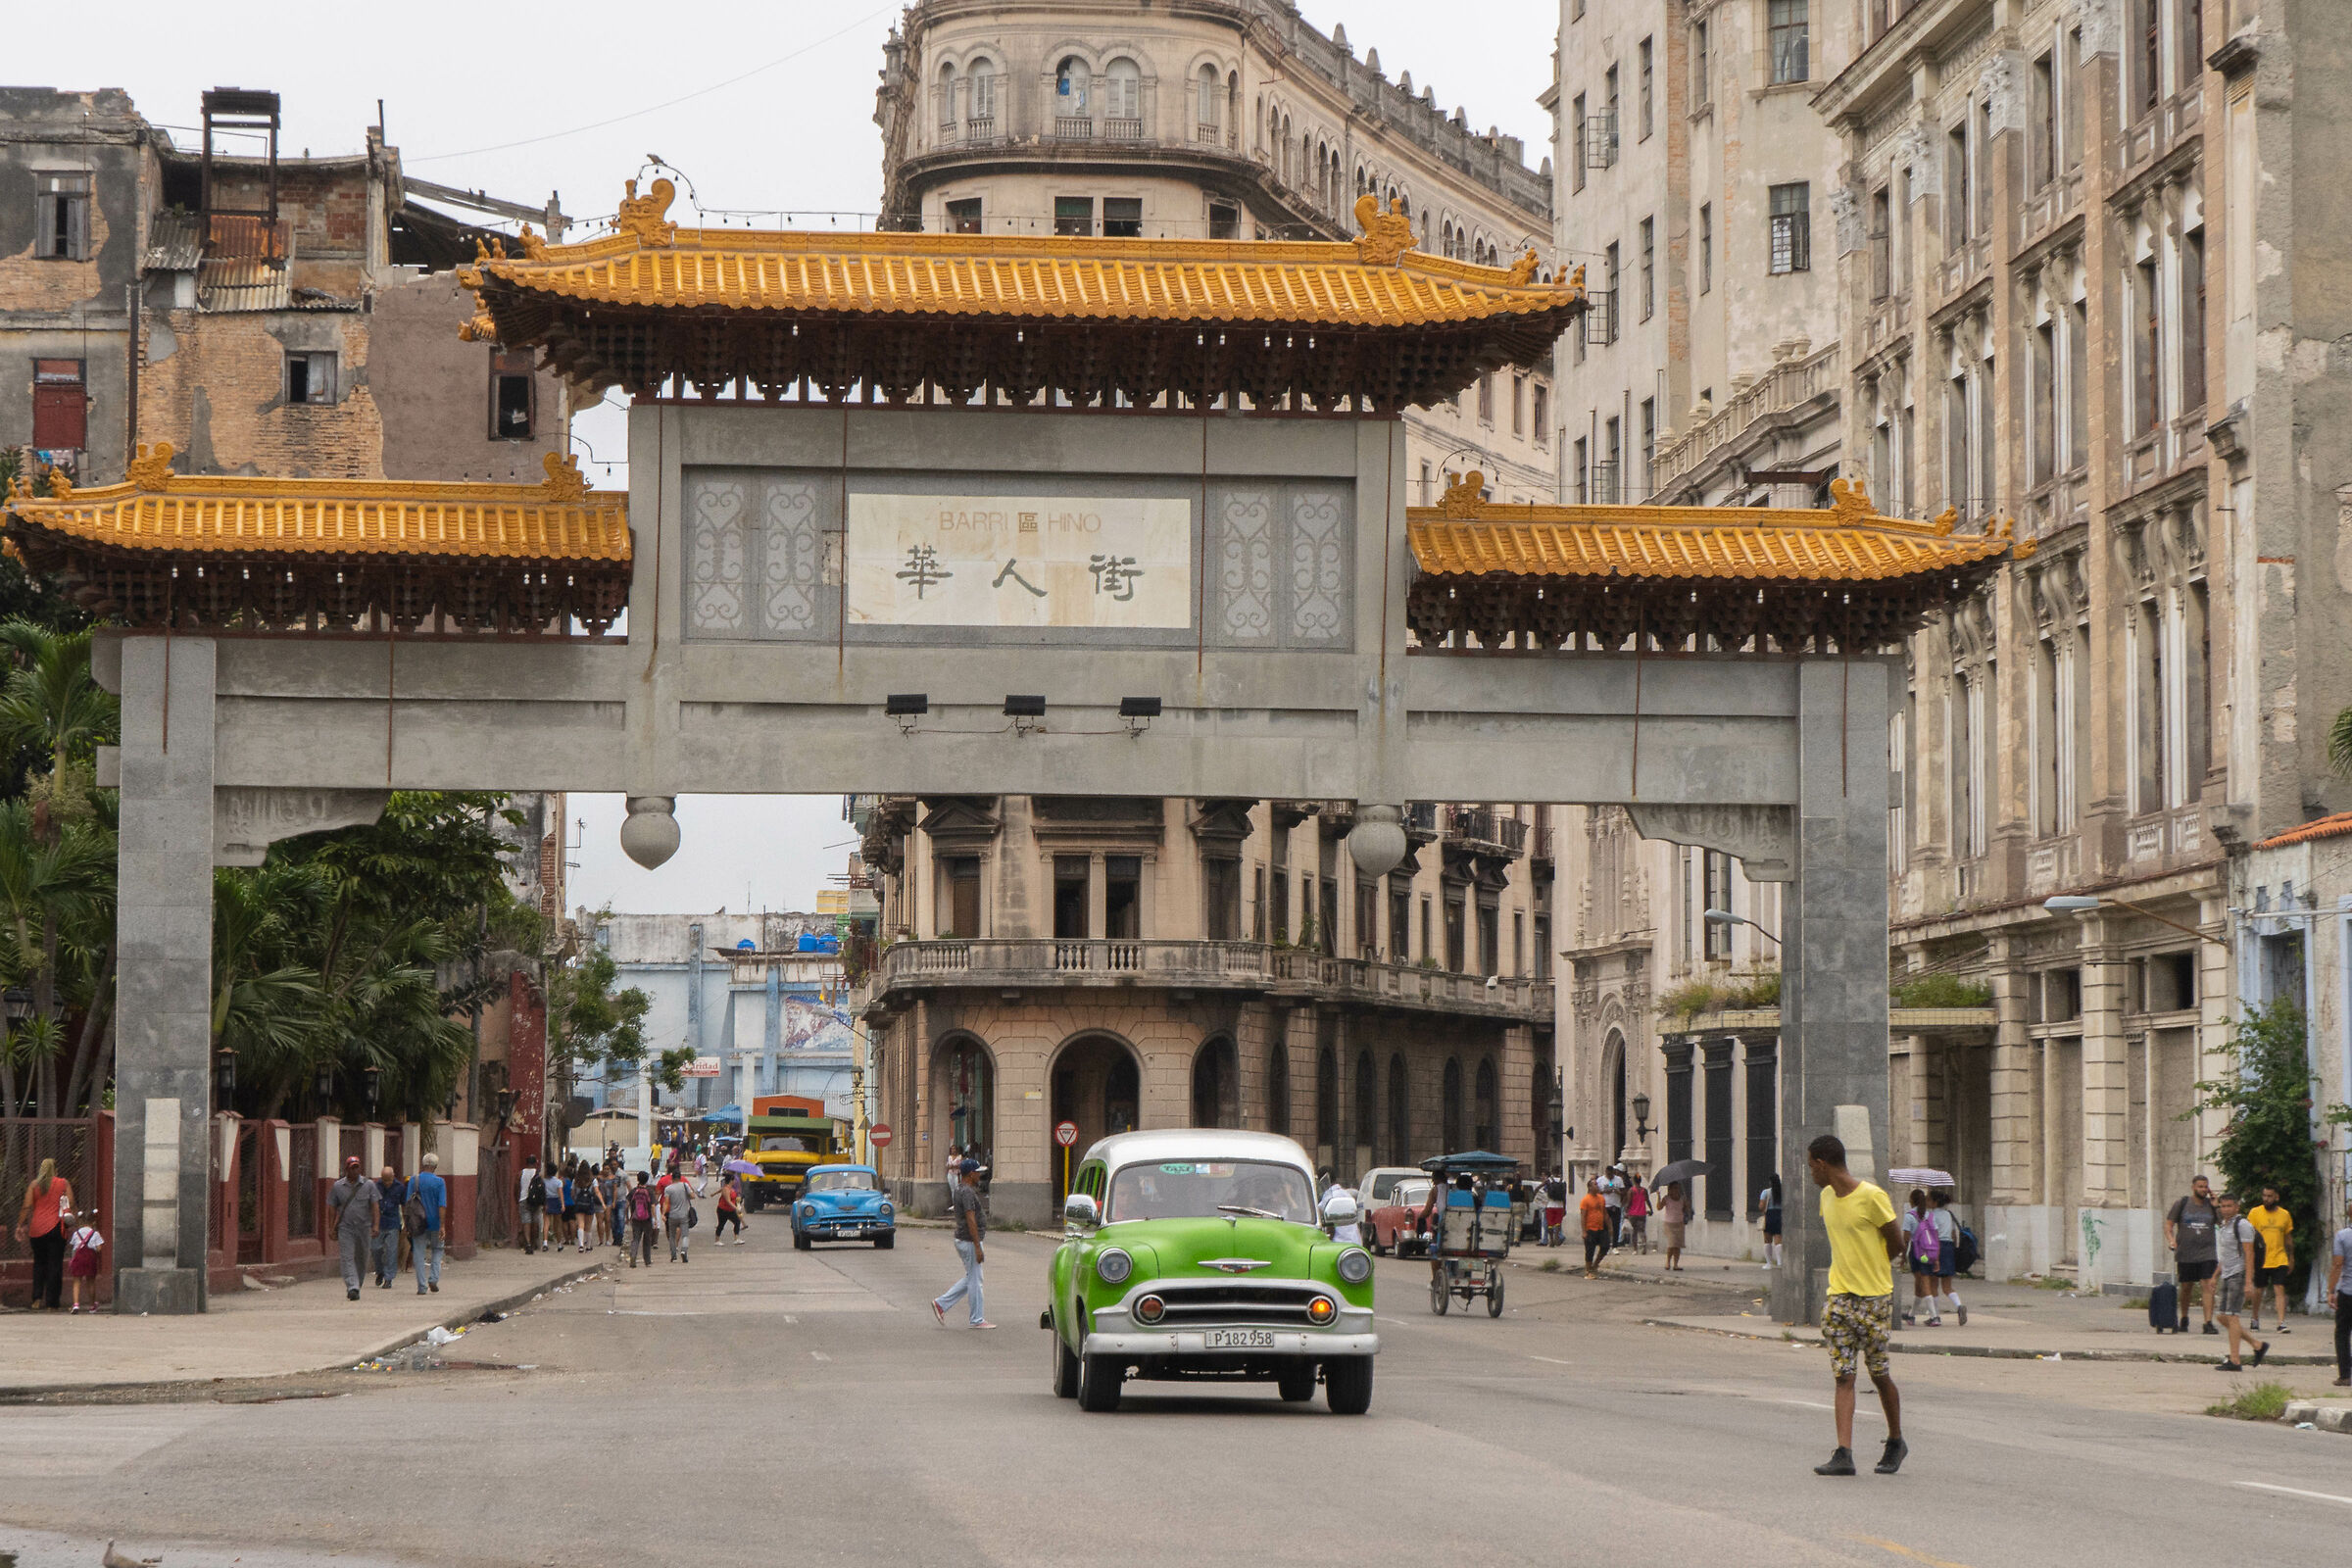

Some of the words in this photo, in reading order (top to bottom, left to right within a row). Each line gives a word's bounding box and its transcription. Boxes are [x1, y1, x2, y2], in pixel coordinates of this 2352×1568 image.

[939, 511, 1008, 531] BARRI
[1048, 513, 1102, 533] HINO
[895, 544, 1146, 603] 華人街
